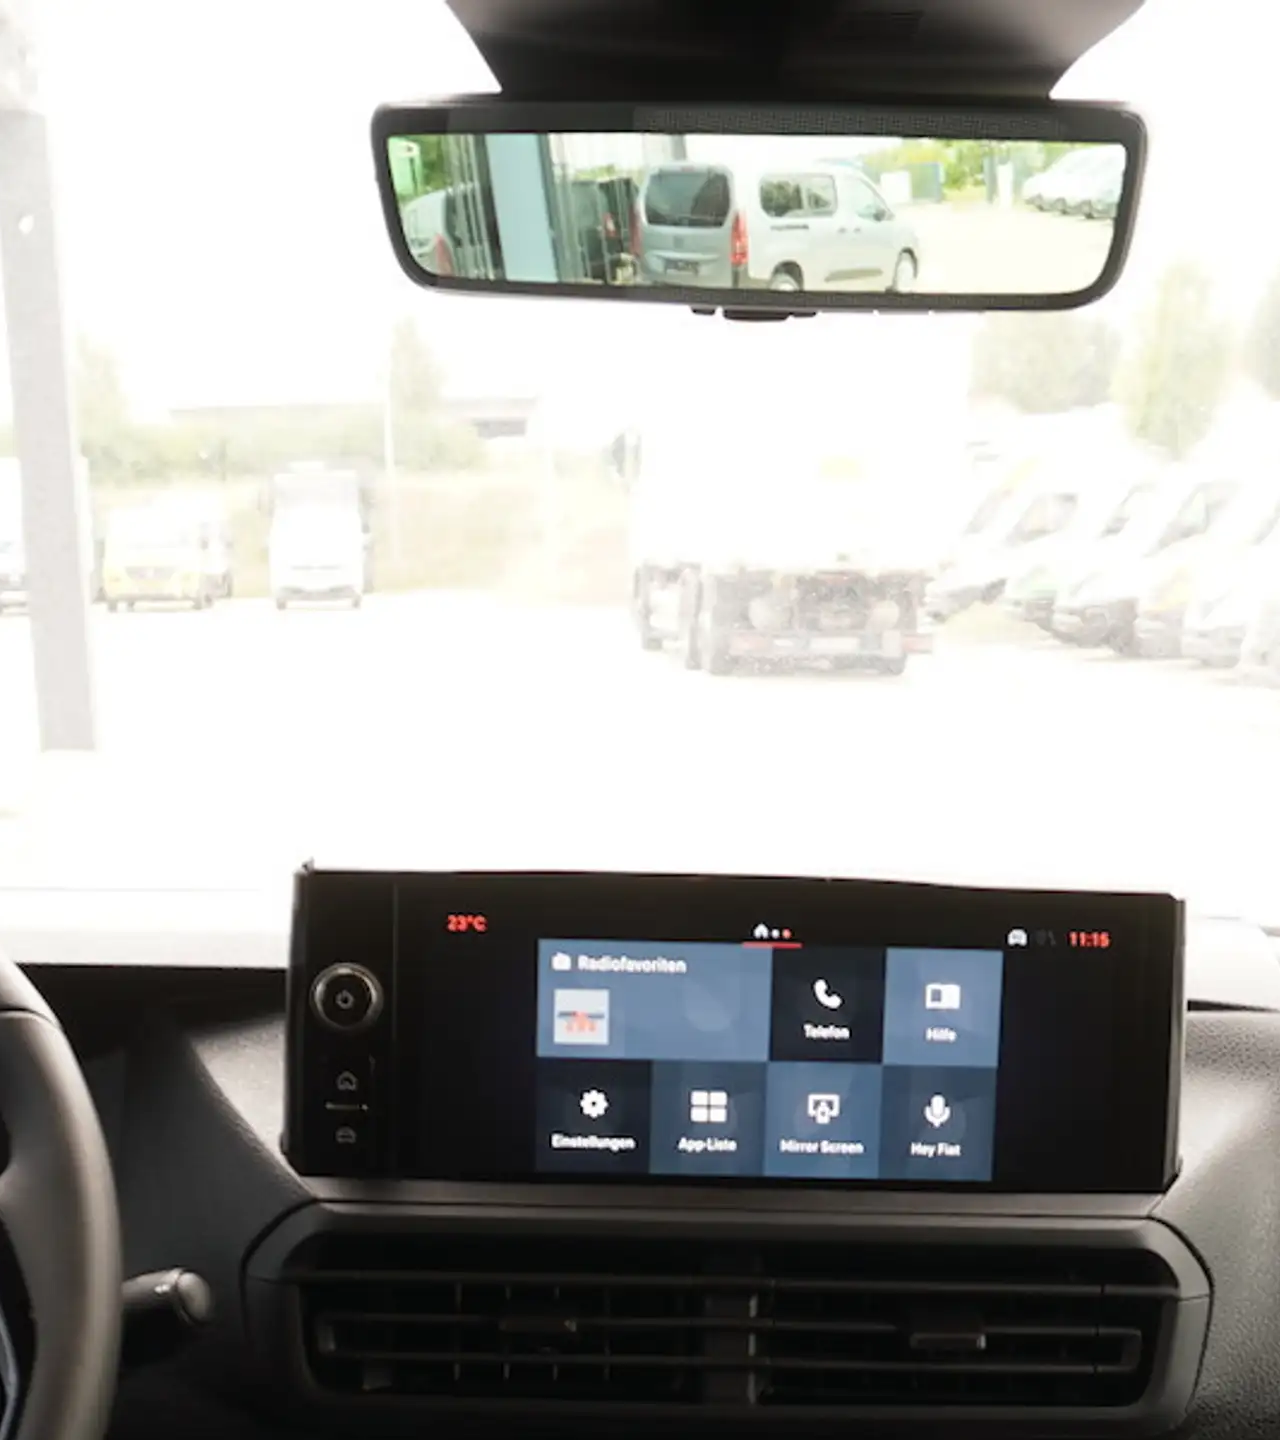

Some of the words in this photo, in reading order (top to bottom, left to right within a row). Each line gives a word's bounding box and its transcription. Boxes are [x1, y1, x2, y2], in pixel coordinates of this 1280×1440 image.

[447, 914, 488, 932] 23°C
[1068, 931, 1110, 948] 11:15
[577, 954, 687, 974] Radiofavoriten
[803, 1023, 850, 1041] Telefon
[925, 1027, 958, 1043] Hilfe
[550, 1133, 637, 1152] Einstellungen
[677, 1136, 738, 1153] App-Liste
[779, 1138, 819, 1154] Mirror
[820, 1139, 864, 1155] Screen
[910, 1141, 935, 1158] Hey
[937, 1141, 962, 1157] Fiat
